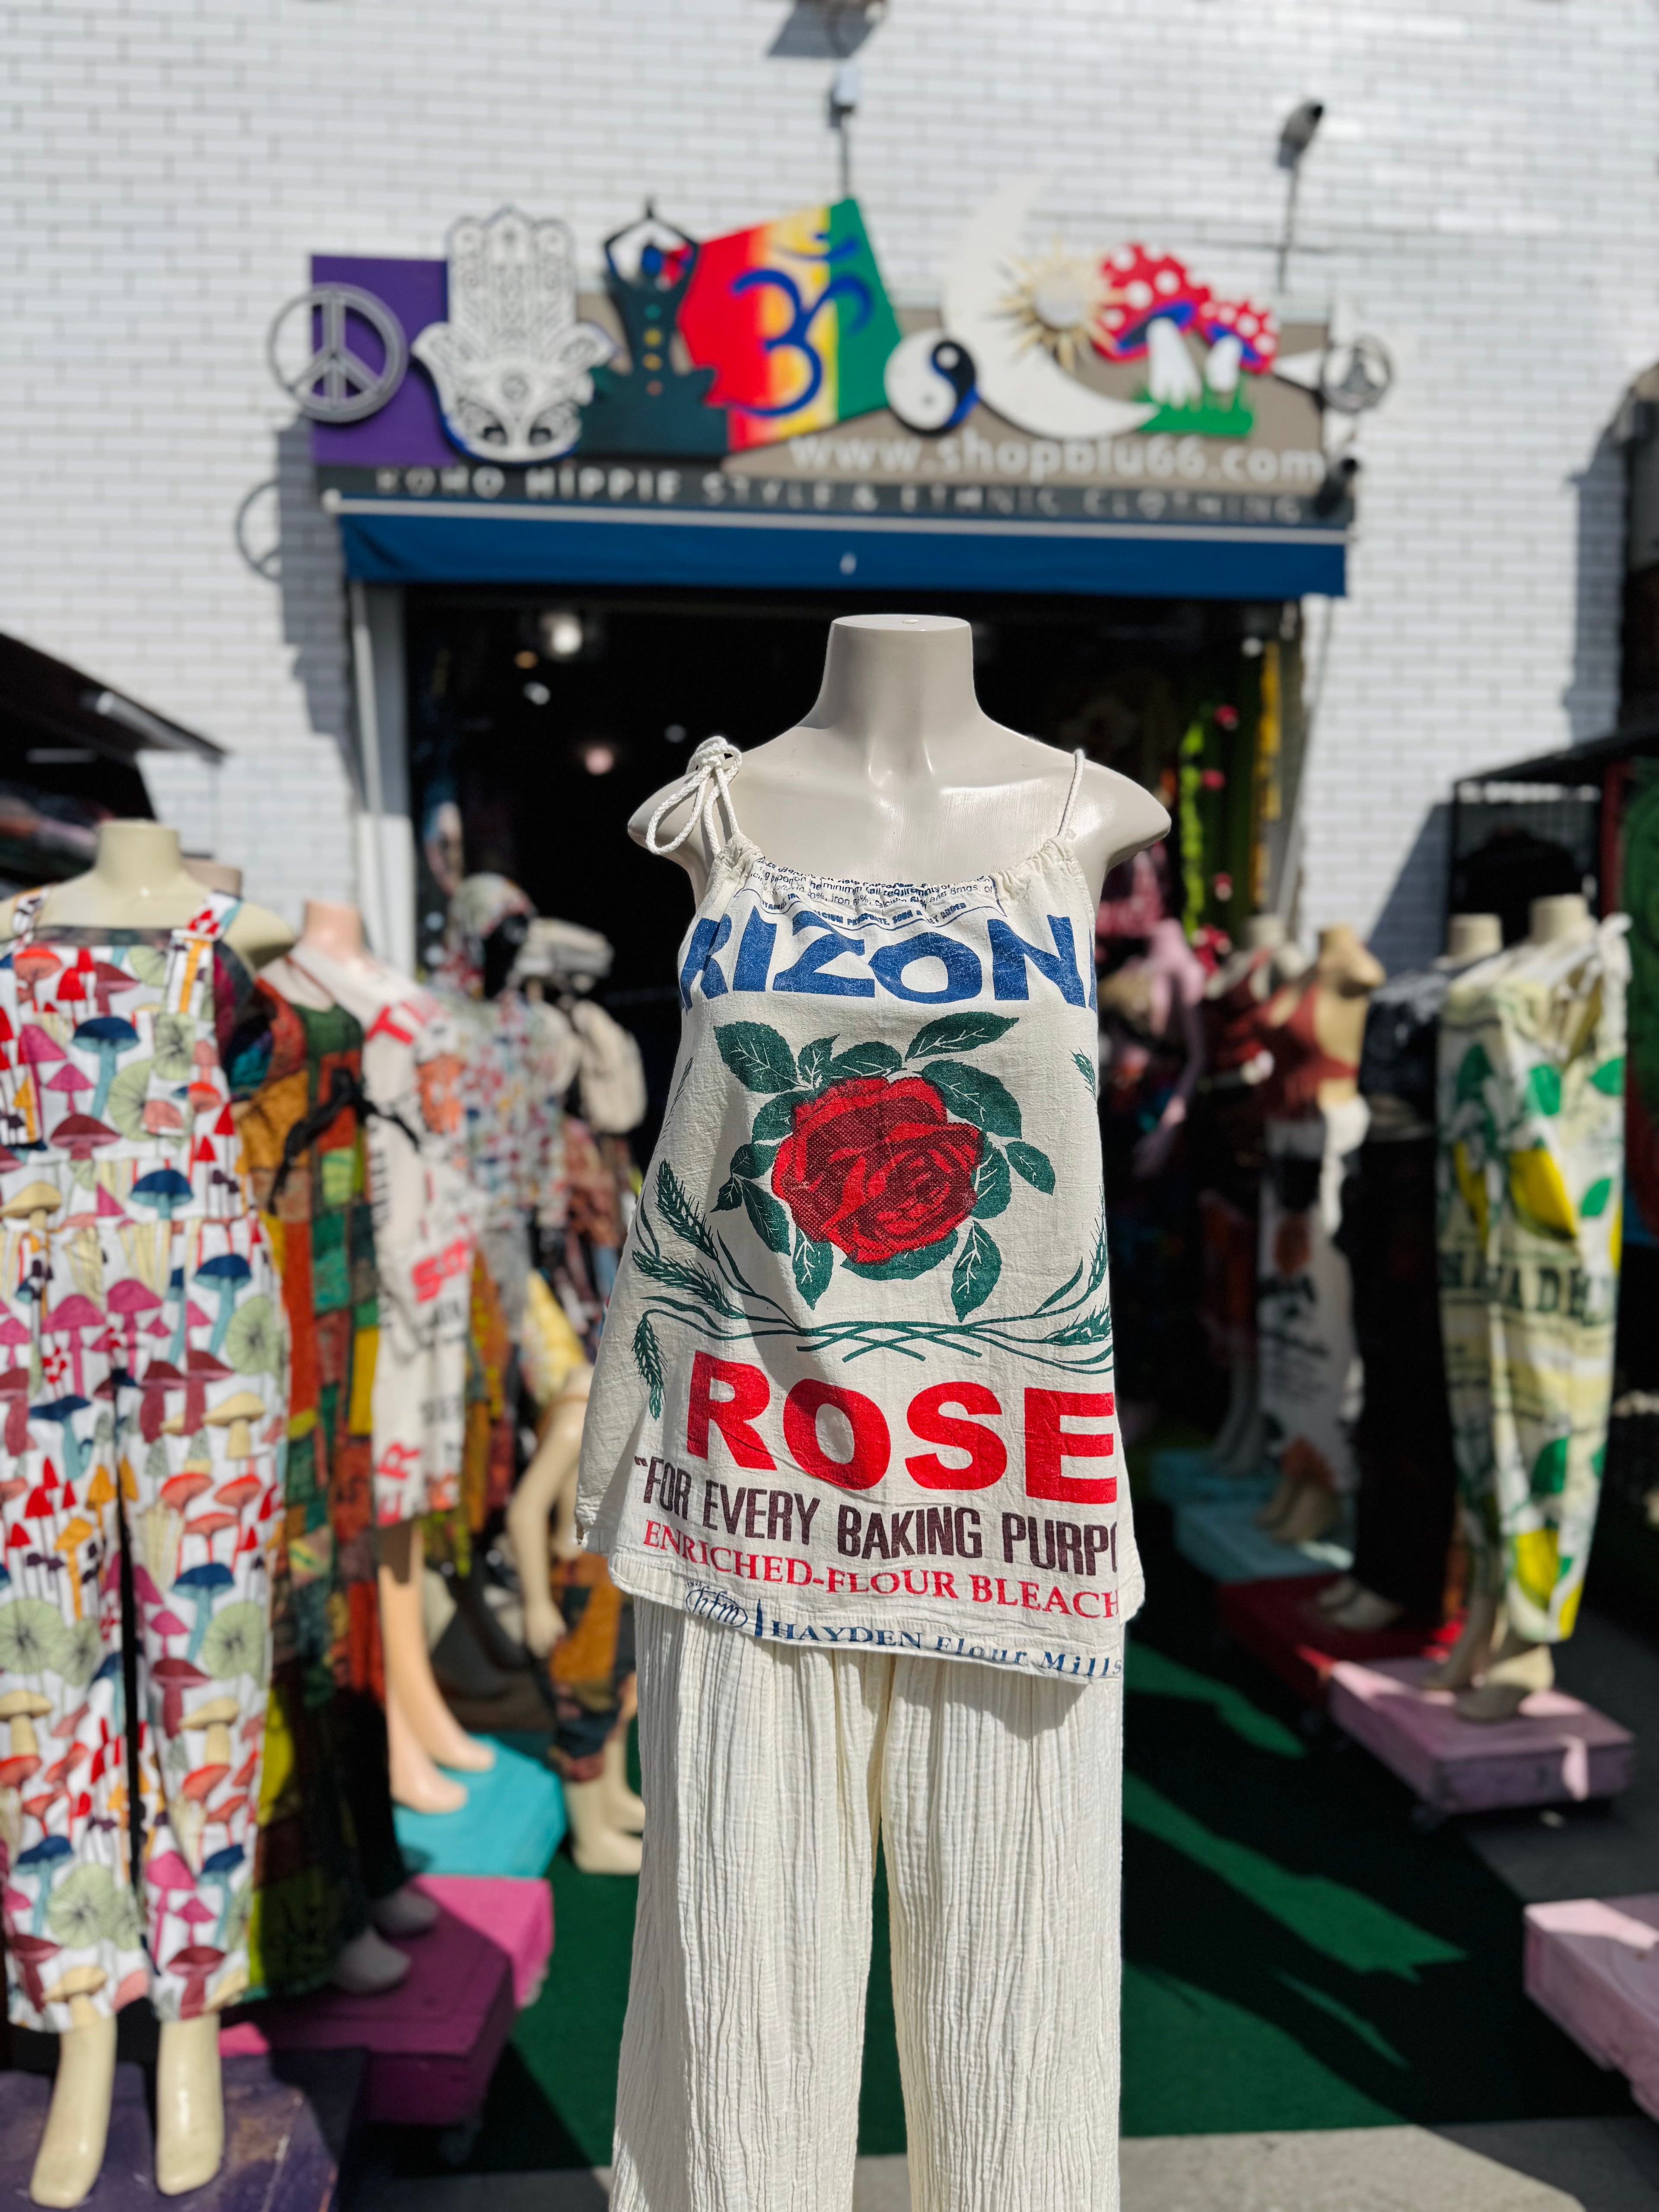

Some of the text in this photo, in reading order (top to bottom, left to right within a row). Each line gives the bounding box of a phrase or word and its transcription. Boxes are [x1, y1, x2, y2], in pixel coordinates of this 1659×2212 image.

[524, 467, 682, 504] HIPPIE
[832, 894, 850, 906] iron
[680, 905, 1098, 1015] RIZON
[686, 1349, 1118, 1504] ROSE
[702, 1479, 821, 1545] EVERY
[837, 1503, 983, 1559] BAKING
[969, 1573, 1119, 1618] BLEACH
[770, 1620, 924, 1649] HAYDEN
[934, 1635, 1028, 1665] Flour
[1040, 1650, 1122, 1677] Mills
